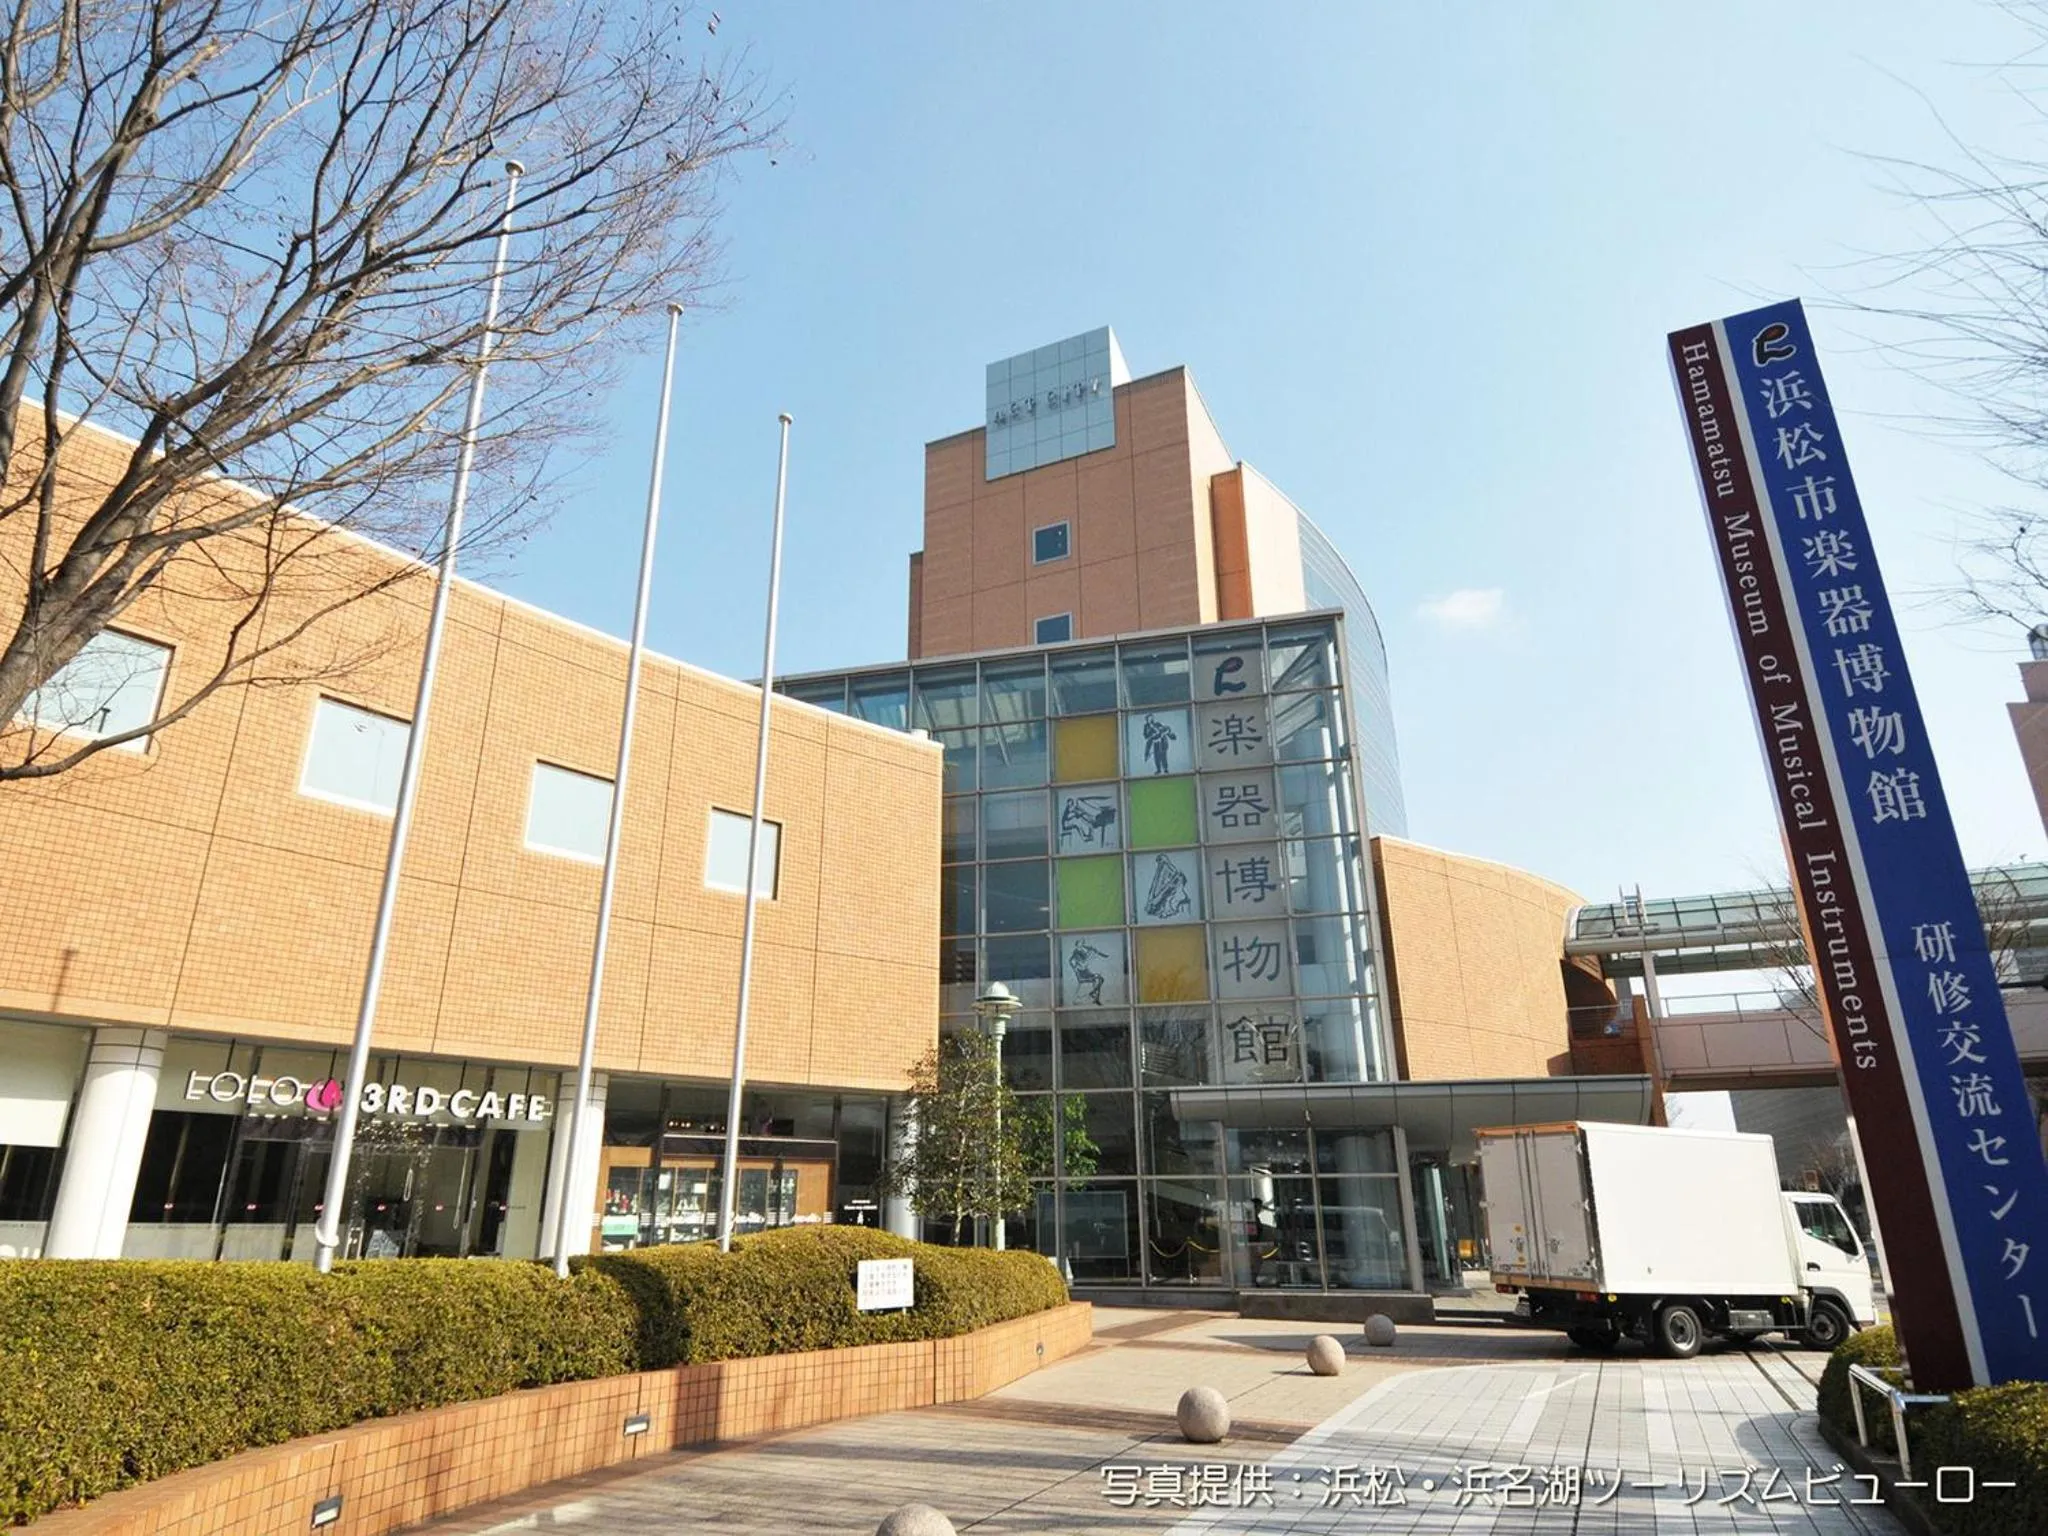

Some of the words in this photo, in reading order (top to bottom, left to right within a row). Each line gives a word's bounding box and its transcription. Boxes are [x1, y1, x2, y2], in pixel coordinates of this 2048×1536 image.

[1681, 341, 1735, 498] Hamamatsu
[1724, 511, 1769, 636] Museum
[1759, 369, 1928, 826] 浜松市楽器博物館
[1758, 655, 1791, 684] of
[1771, 702, 1826, 831] Musical
[1207, 713, 1293, 1066] 楽器博物館
[1807, 851, 1877, 1070] Instruments
[360, 1082, 440, 1116] 3RD
[450, 1089, 546, 1122] CAFE
[1911, 921, 2037, 1338] 研修交流センター
